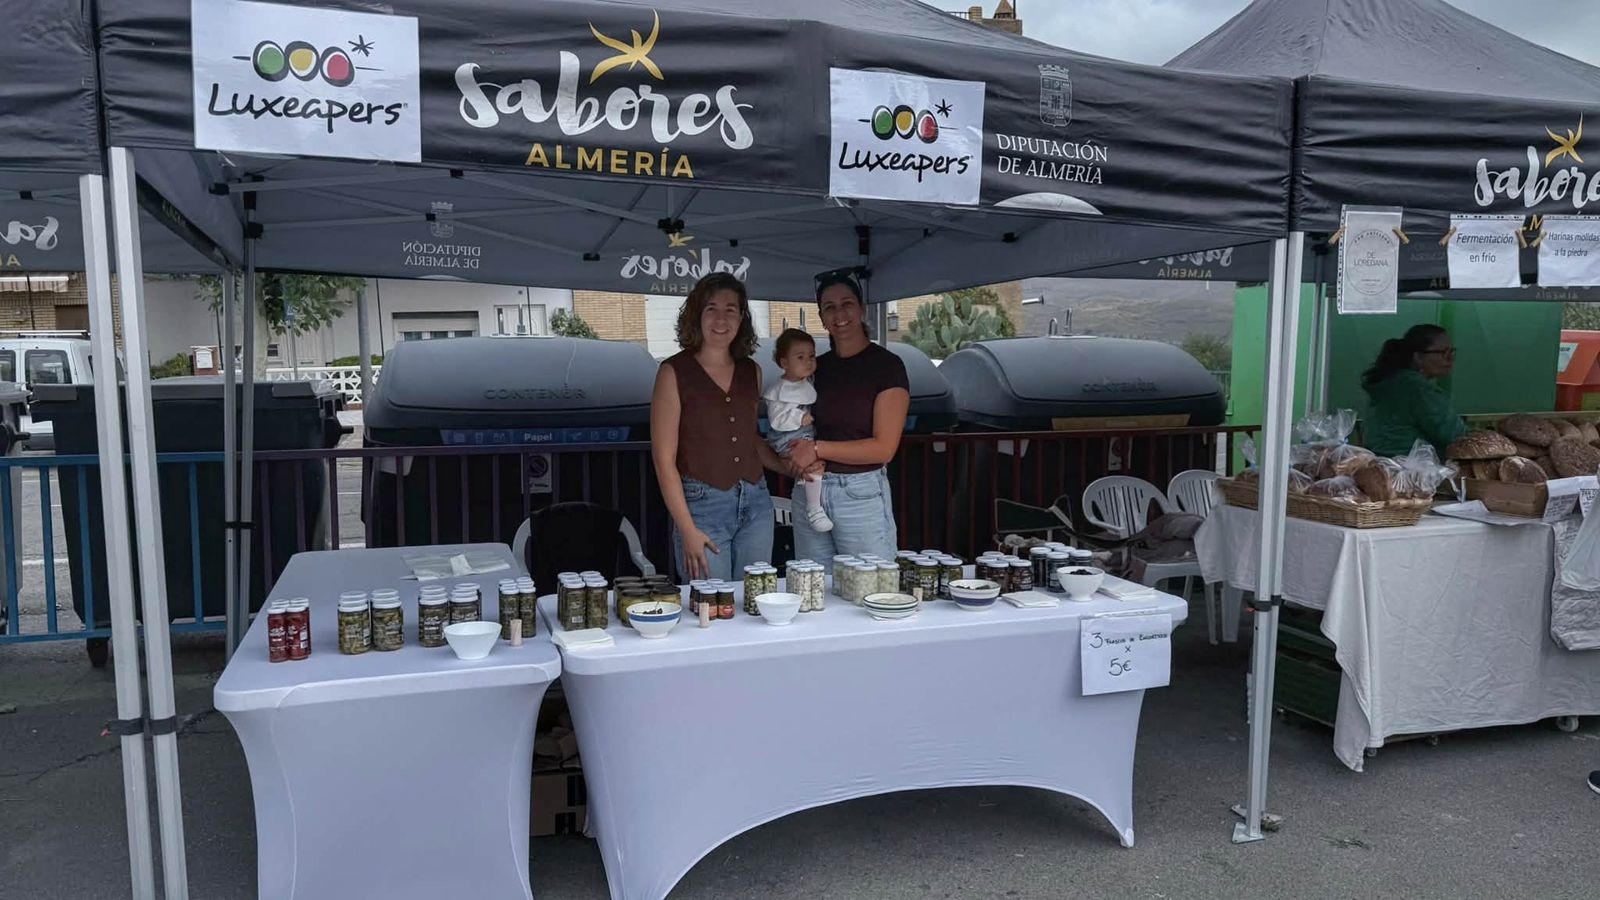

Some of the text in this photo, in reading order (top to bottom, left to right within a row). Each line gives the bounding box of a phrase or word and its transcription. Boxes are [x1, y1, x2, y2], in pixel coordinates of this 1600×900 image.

[208, 82, 403, 133] Luxeapers
[996, 133, 1108, 163] DIPUTACIÓN
[524, 143, 694, 179] ALMERÍA
[838, 142, 970, 182] Luxeapers
[998, 155, 1104, 185] DE ALMERÍA
[1456, 232, 1514, 245] Fermentación
[1548, 231, 1600, 242] Harinas molidas
[1469, 254, 1480, 263] en
[1560, 248, 1566, 256] la
[1567, 248, 1588, 258] piedra
[1353, 259, 1389, 267] LOREDANA
[524, 432, 553, 442] Papel
[1090, 632, 1104, 648] 3
[1108, 657, 1132, 676] 5€
